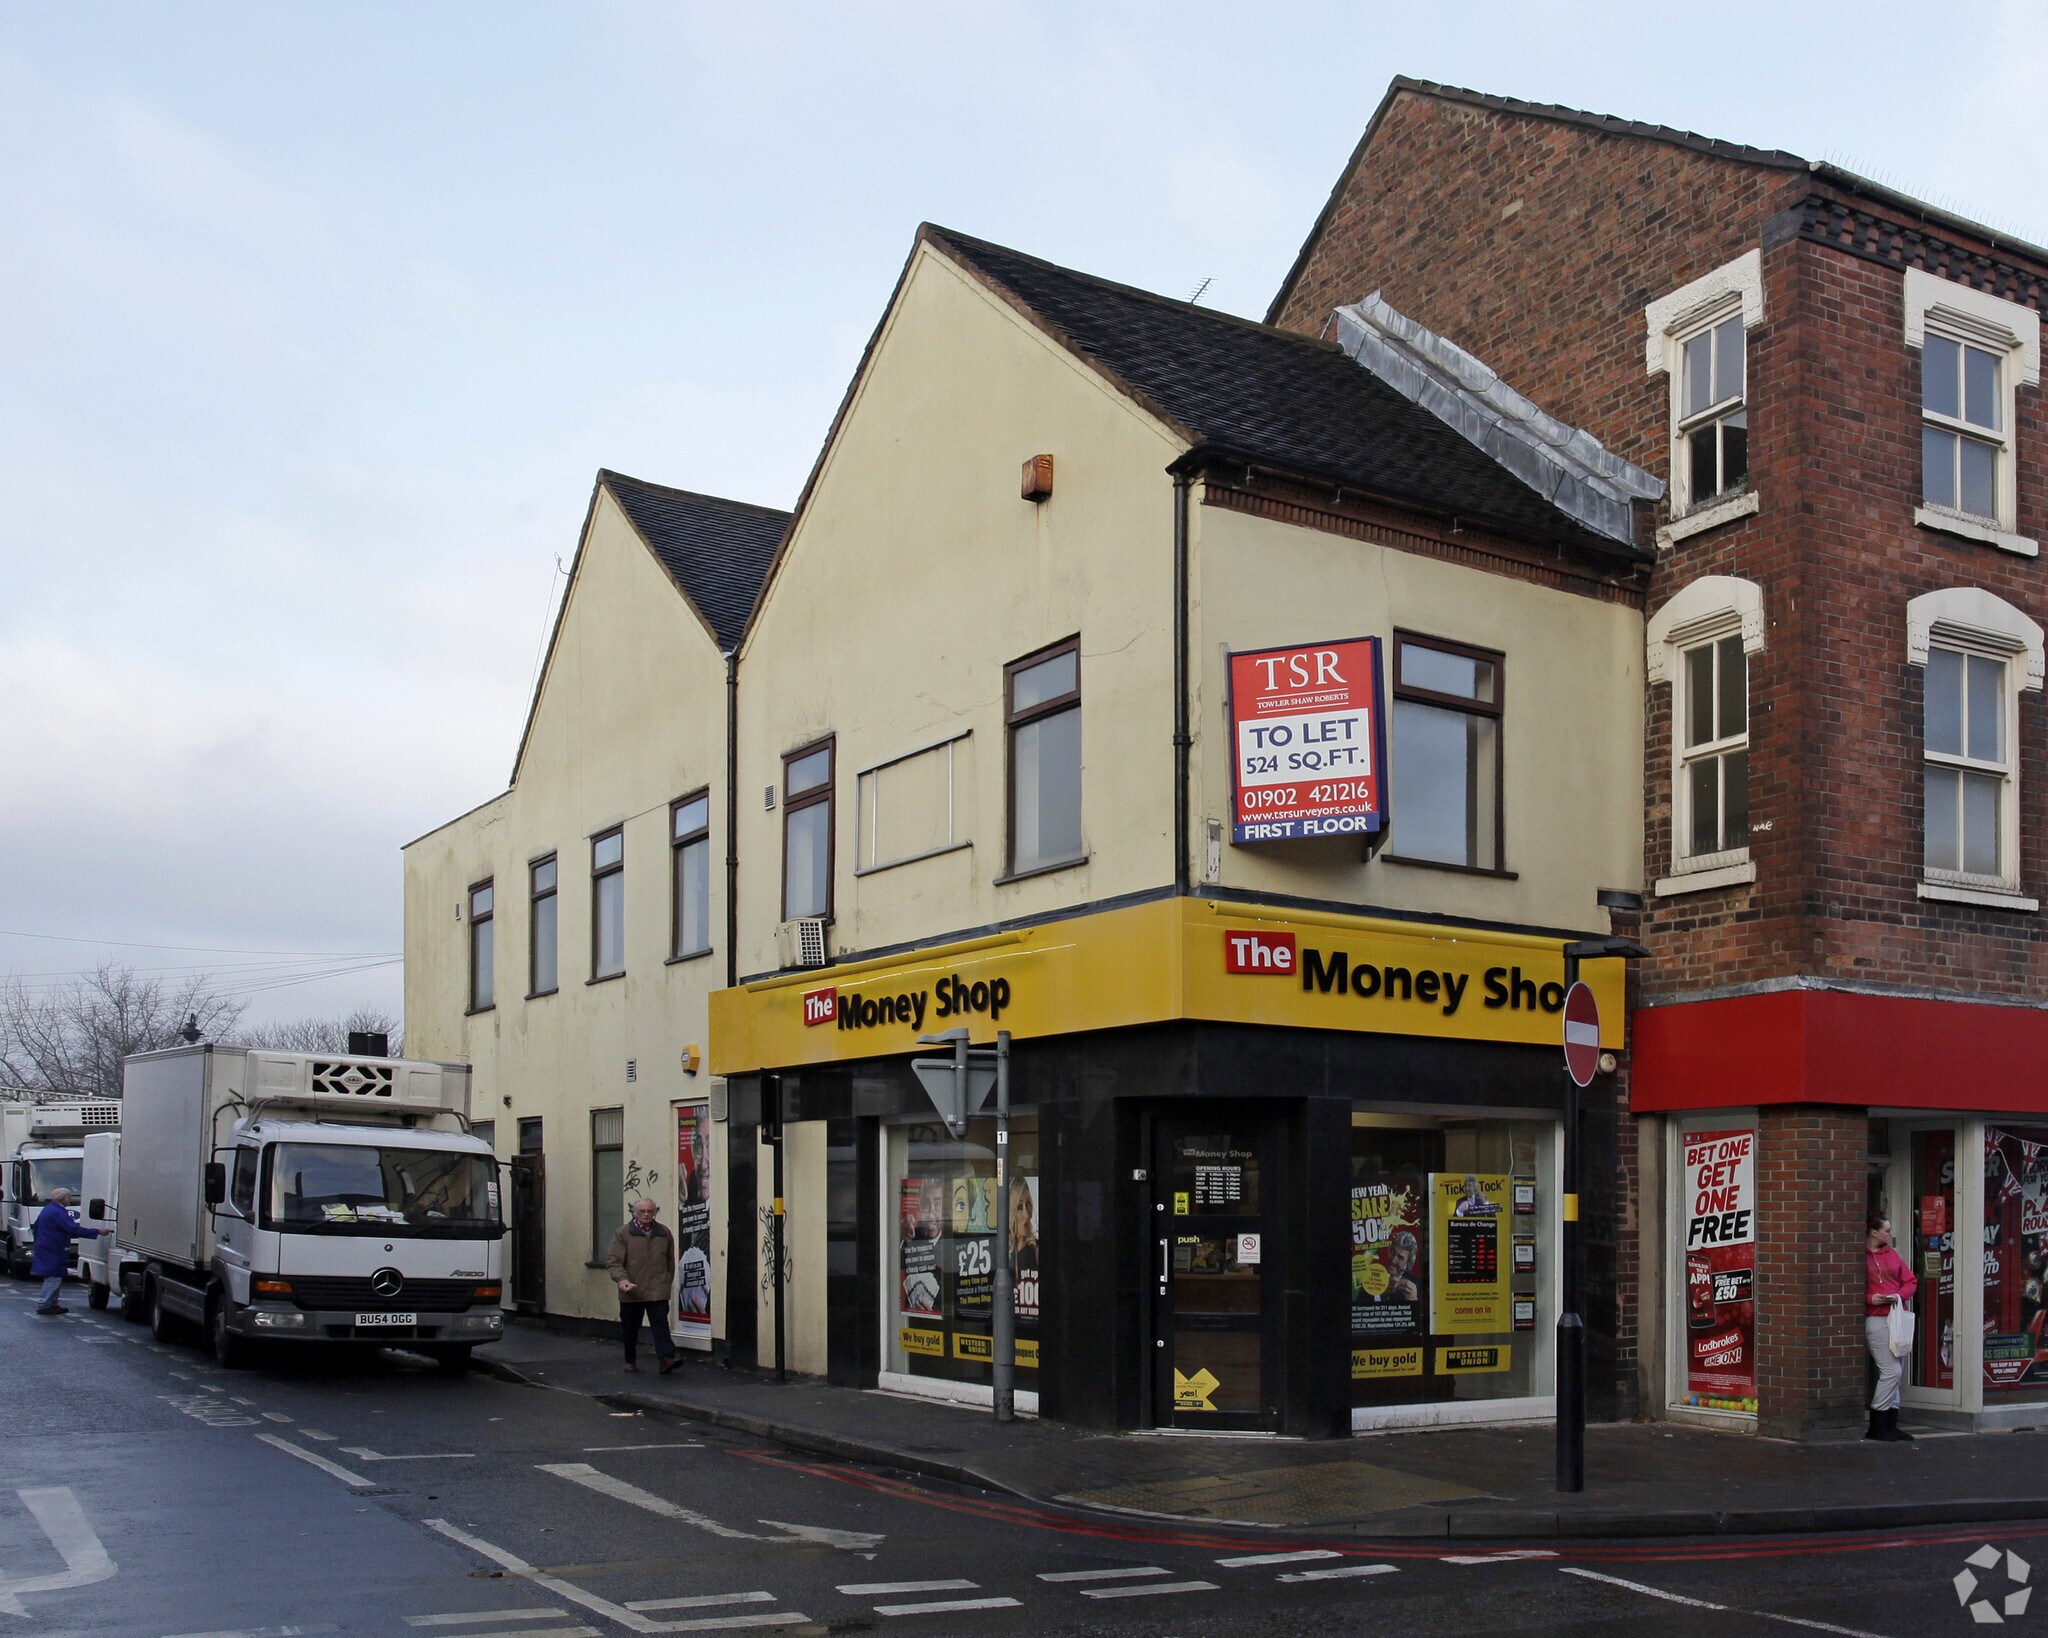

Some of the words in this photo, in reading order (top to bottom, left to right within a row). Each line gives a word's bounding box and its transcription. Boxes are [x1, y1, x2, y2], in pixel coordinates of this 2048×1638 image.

[1255, 651, 1348, 691] TSR
[1257, 699, 1290, 709] TOWLER
[1291, 696, 1314, 706] SHAW
[1314, 692, 1349, 703] ROBERTS
[1249, 725, 1293, 749] TO
[1302, 718, 1359, 744] LET
[1246, 755, 1278, 774] 524
[1288, 747, 1365, 771] SQ.FT.
[1244, 788, 1297, 808] 01902
[1309, 781, 1369, 802] 421216
[1241, 801, 1372, 822] www.tsrsurveyors.co.uk
[1245, 822, 1295, 840] FIRST
[1303, 816, 1367, 835] FLOOR
[1231, 938, 1292, 969] The
[1302, 948, 1469, 1015] Money
[1483, 966, 1565, 1013] Sho
[806, 995, 833, 1021] The
[838, 990, 927, 1031] Money
[935, 974, 1011, 1020] Shop
[998, 1132, 1003, 1142] 1
[1195, 1150, 1227, 1159] Money
[1229, 1150, 1253, 1159] Shop
[1687, 1144, 1717, 1166] BET
[1718, 1137, 1751, 1160] ONE
[1697, 1158, 1742, 1190] GET
[1367, 1183, 1388, 1196] YEAR
[1351, 1196, 1390, 1220] SALE
[1695, 1185, 1740, 1216] ONE
[1688, 1209, 1751, 1246] FREE
[1178, 1236, 1200, 1244] push
[958, 1239, 991, 1276] £25
[1020, 1269, 1030, 1280] get
[1030, 1270, 1039, 1280] up
[1690, 1273, 1710, 1284] APP!
[1715, 1278, 1730, 1287] FREE
[1731, 1276, 1743, 1285] BET
[1715, 1285, 1737, 1300] £50
[1455, 1306, 1473, 1315] come
[1484, 1306, 1491, 1314] in
[360, 1314, 389, 1324] BU54
[391, 1314, 413, 1323] OGG
[902, 1332, 912, 1342] We
[913, 1333, 925, 1346] buy
[926, 1335, 940, 1346] gold
[1698, 1333, 1739, 1352] Ladbrokes
[968, 1346, 987, 1354] UNION
[1448, 1350, 1489, 1359] WESTERN
[1720, 1347, 1742, 1365] ON!
[1984, 1350, 1992, 1358] AS
[1993, 1348, 2010, 1358] SEEN
[2010, 1348, 2019, 1358] ON
[2019, 1347, 2029, 1357] TV
[1369, 1354, 1389, 1368] buy
[1393, 1352, 1417, 1367] gold
[1460, 1358, 1488, 1366] UNION
[1180, 1389, 1198, 1398] yes!
